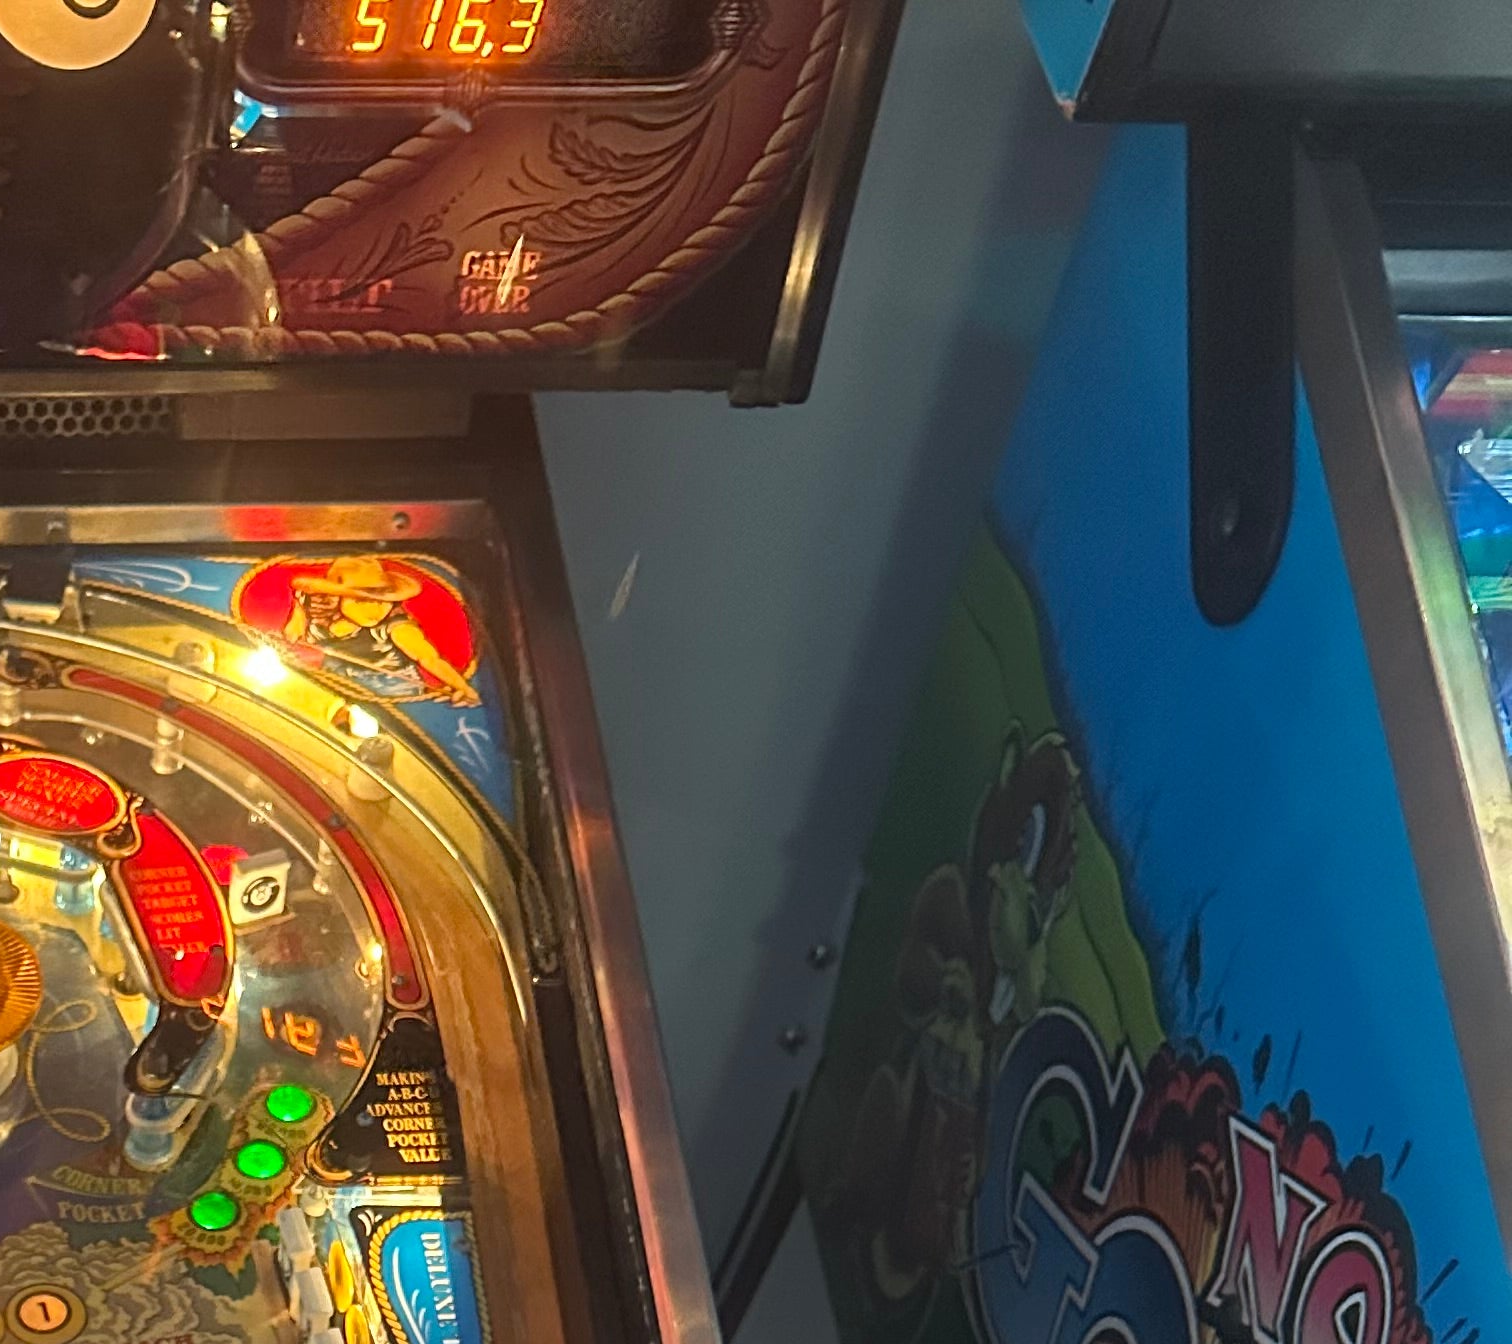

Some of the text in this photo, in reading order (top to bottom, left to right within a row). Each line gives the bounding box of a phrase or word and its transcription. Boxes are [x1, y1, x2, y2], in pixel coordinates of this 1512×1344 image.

[461, 250, 542, 281] GAME
[459, 285, 531, 314] OVER
[57, 1201, 146, 1223] POCKET
[420, 1232, 458, 1328] DELUXE
[37, 1301, 51, 1323] 1
